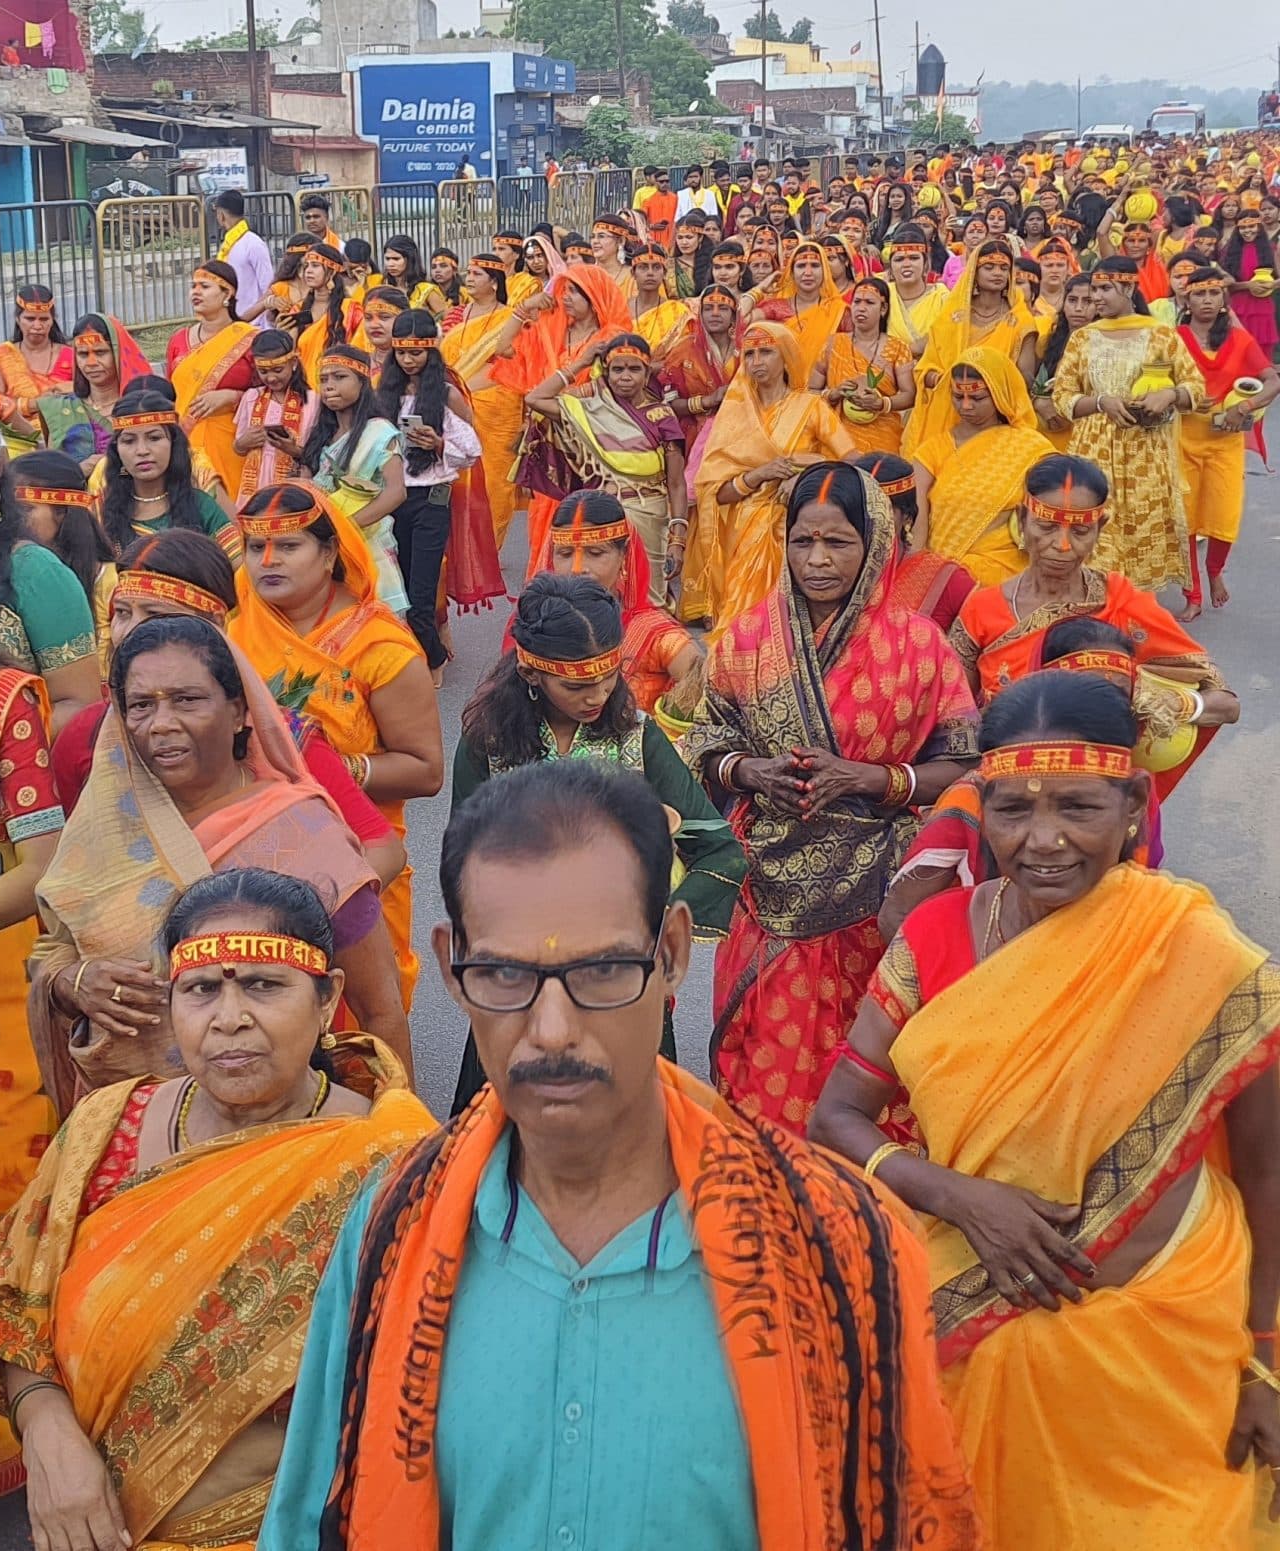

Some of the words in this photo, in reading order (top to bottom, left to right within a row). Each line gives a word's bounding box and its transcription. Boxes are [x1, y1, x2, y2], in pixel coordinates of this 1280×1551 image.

[381, 98, 476, 121] Dalmia
[416, 122, 475, 135] cement
[383, 143, 431, 152] FUTURE
[436, 142, 476, 152] TODAY
[181, 937, 220, 962] जय
[224, 935, 289, 960] माता
[292, 939, 311, 965] दी
